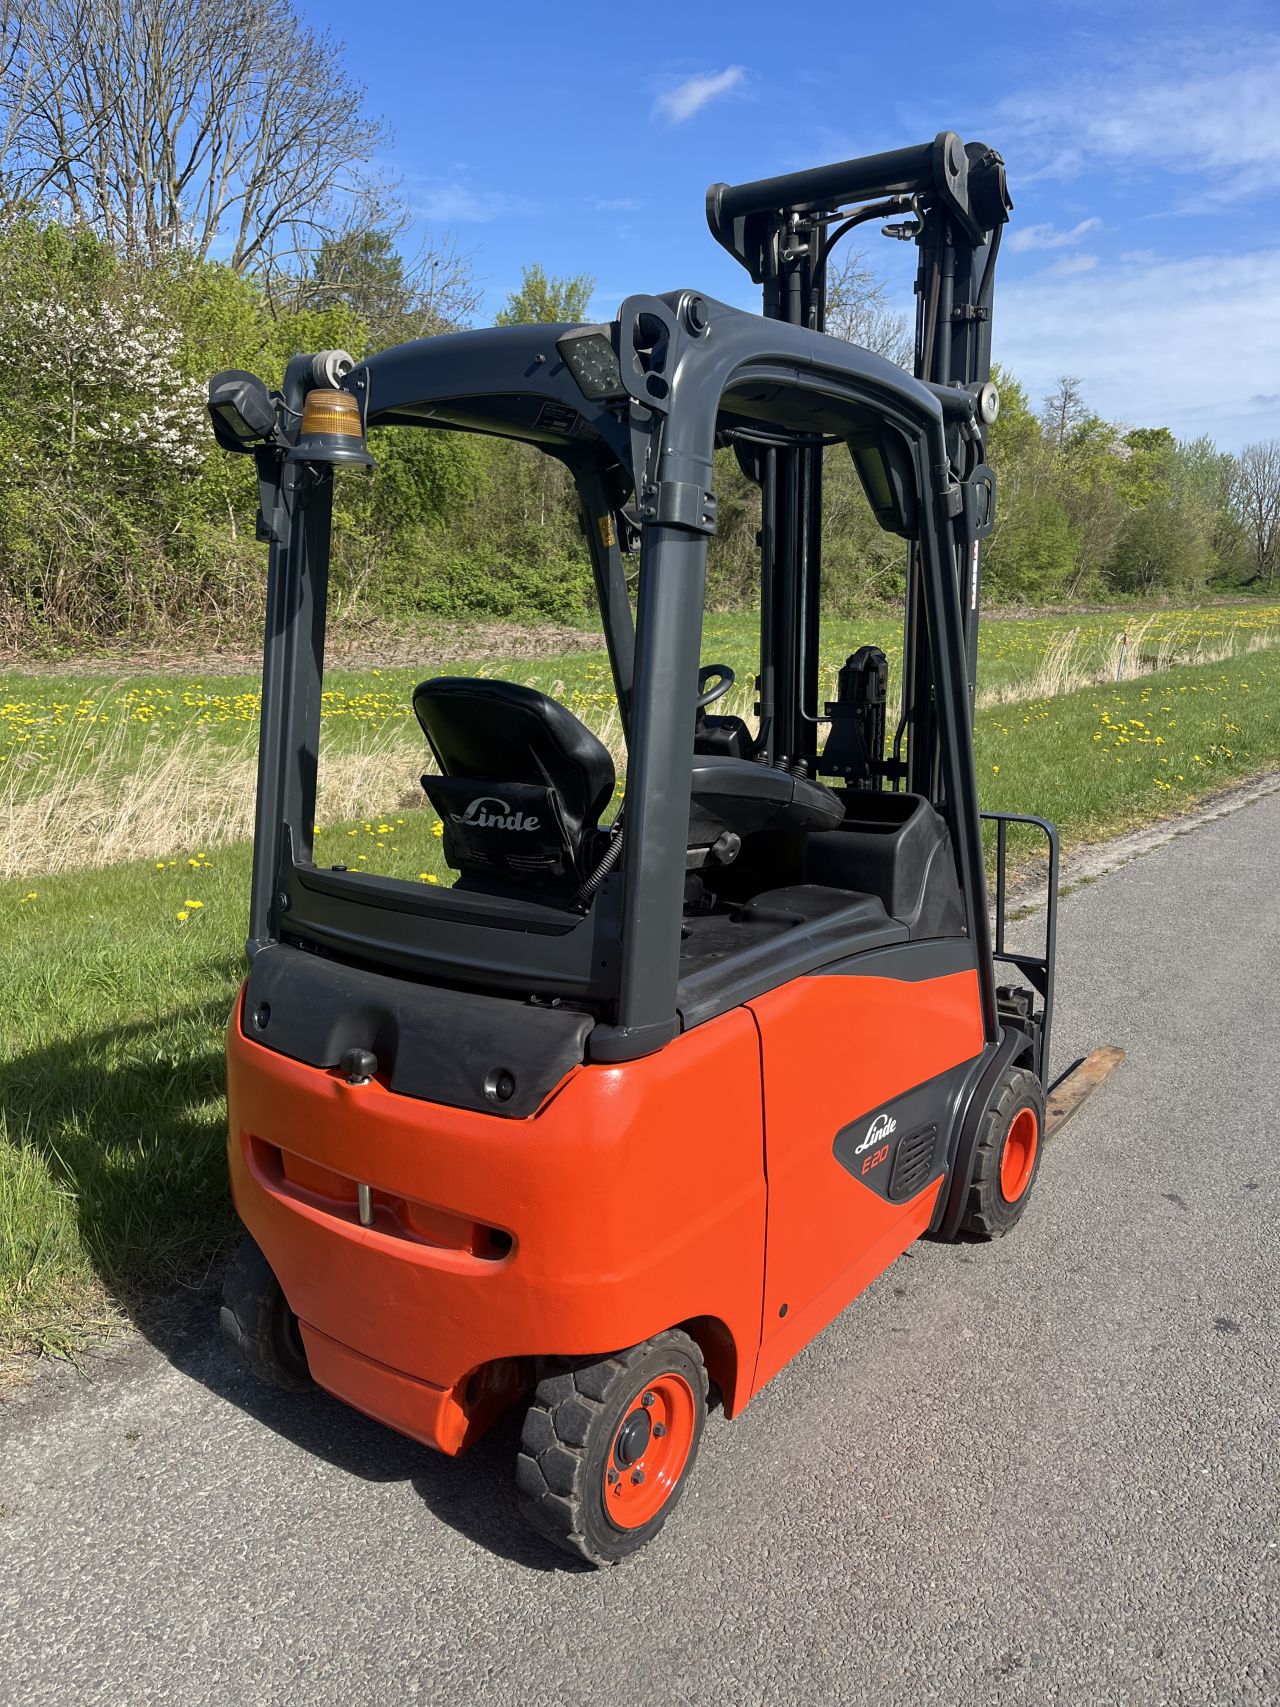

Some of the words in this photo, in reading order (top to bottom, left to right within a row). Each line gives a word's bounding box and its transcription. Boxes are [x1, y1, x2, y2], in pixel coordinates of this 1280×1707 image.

[450, 797, 541, 831] Linde
[855, 1113, 896, 1154] Linde
[861, 1144, 889, 1175] E20
